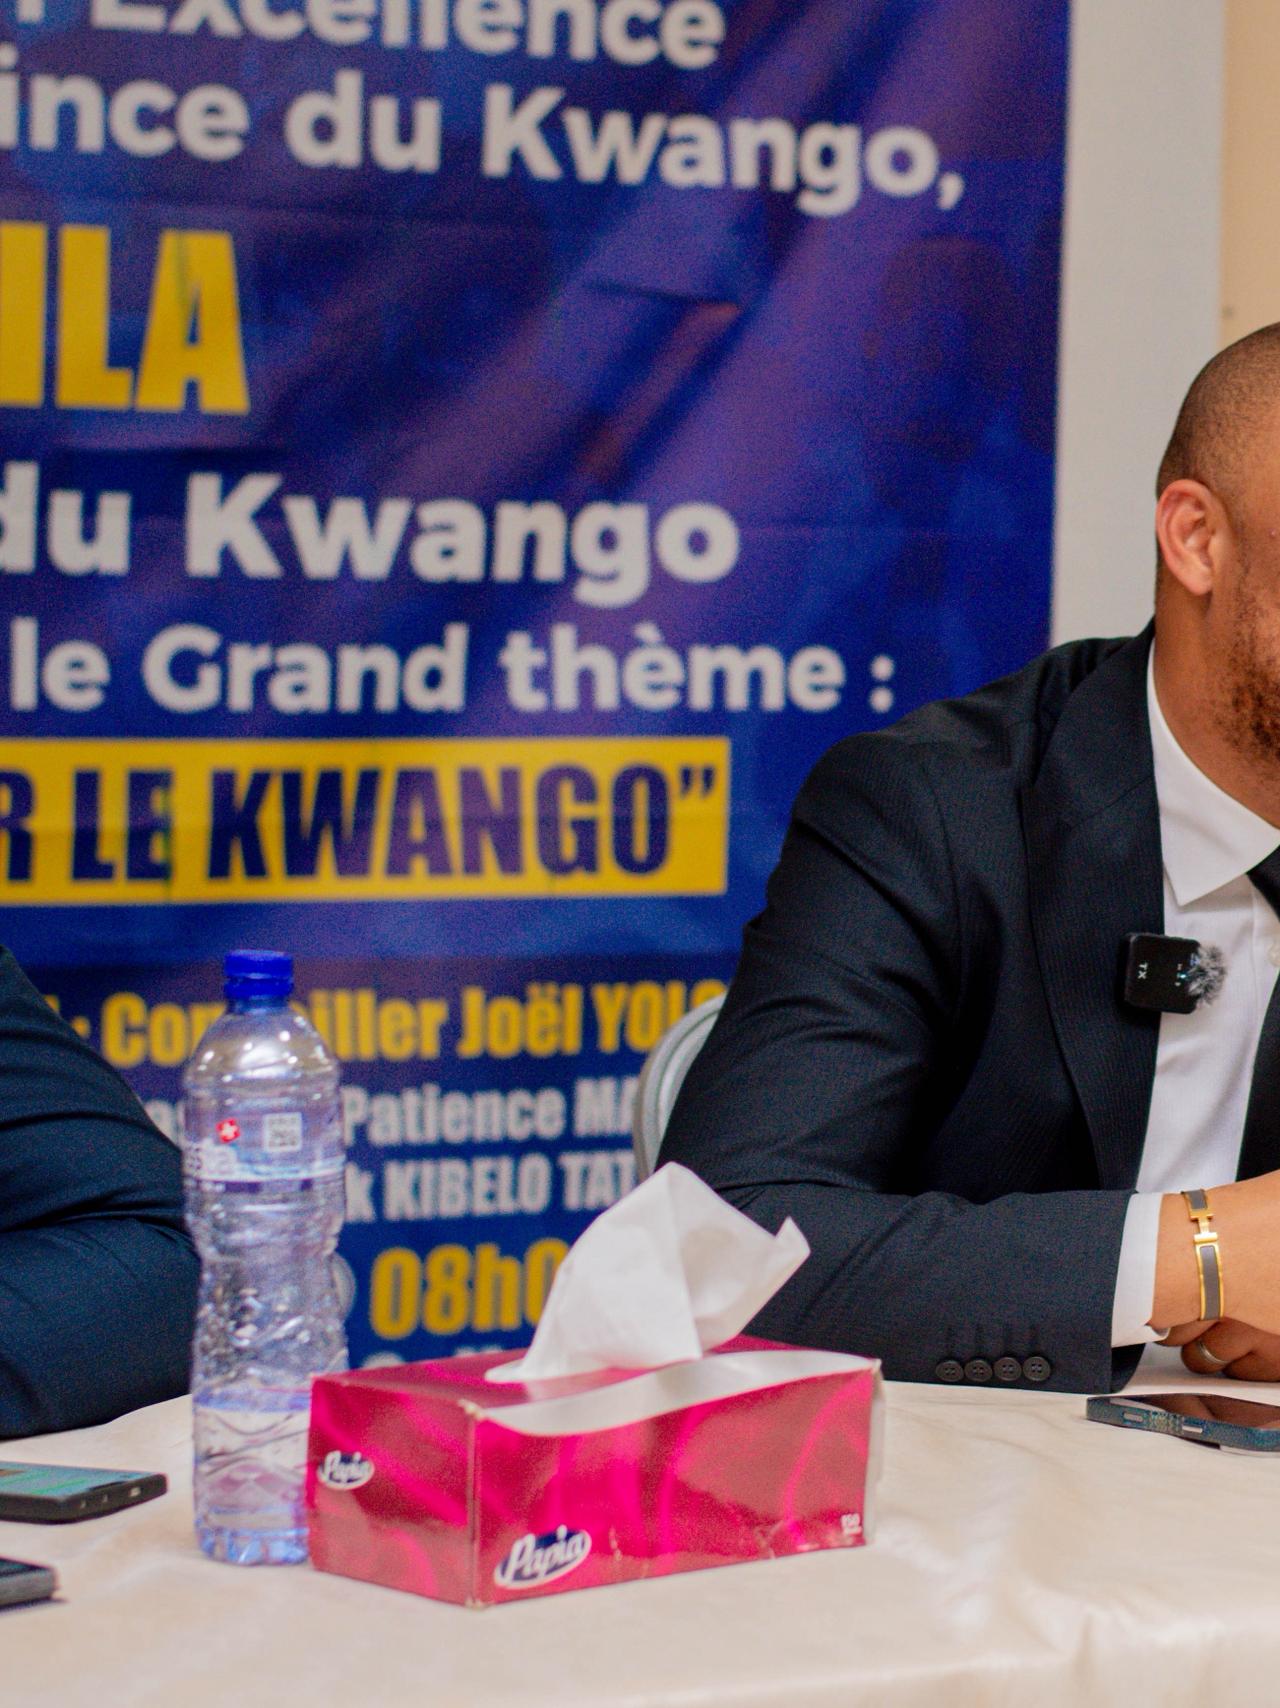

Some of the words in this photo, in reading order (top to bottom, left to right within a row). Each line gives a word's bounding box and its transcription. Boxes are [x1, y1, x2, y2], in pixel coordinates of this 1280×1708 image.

[284, 67, 442, 172] du
[482, 83, 964, 219] Kwango,
[185, 473, 741, 610] Kwango
[11, 617, 110, 712] le
[142, 622, 468, 713] Grand
[499, 620, 845, 714] thème
[70, 768, 174, 883] LE
[456, 980, 583, 1059] Joël
[342, 1082, 566, 1146] Patience
[382, 1153, 551, 1221] KIBELO
[322, 1450, 373, 1487] Papia
[501, 1524, 590, 1584] Papia
